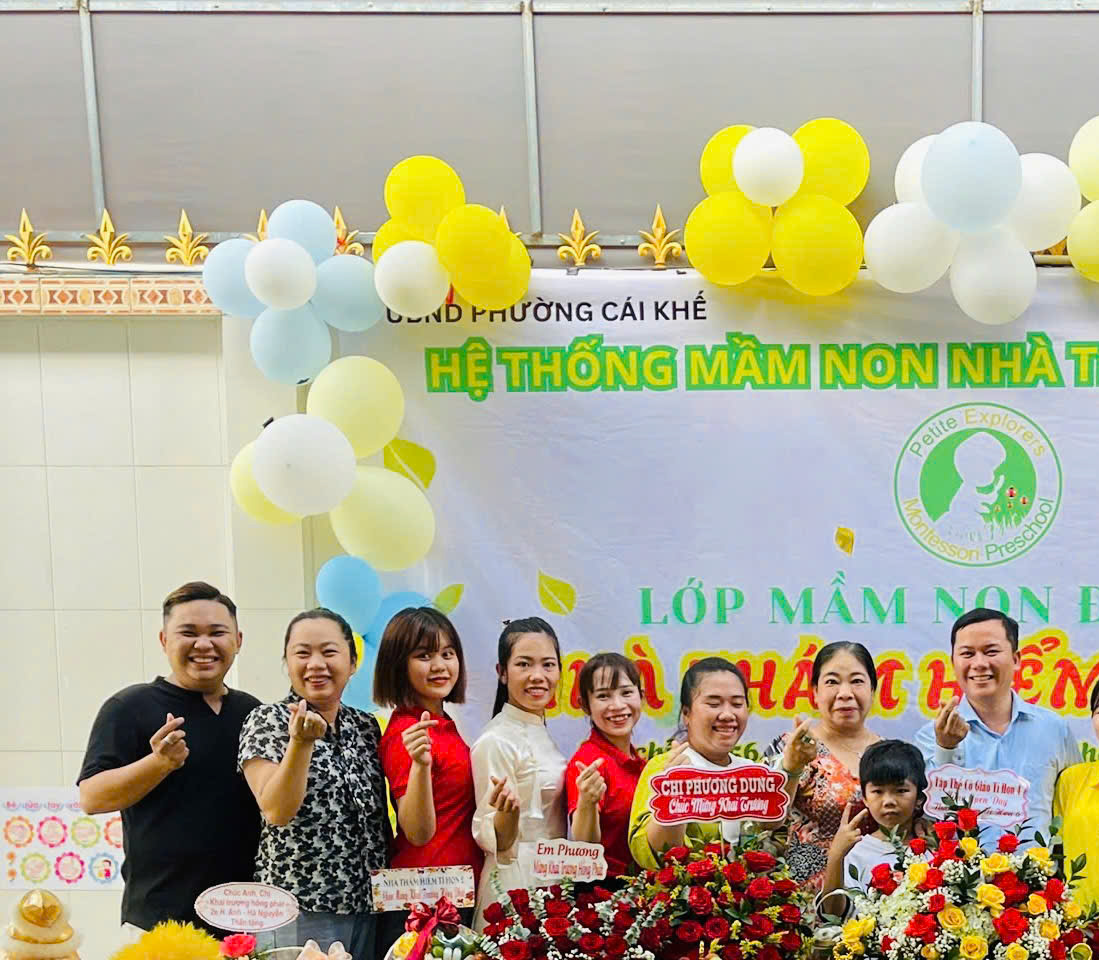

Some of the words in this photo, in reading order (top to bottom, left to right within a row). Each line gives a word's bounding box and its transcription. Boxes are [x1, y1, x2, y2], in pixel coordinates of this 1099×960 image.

[471, 297, 593, 323] PHƯỜNG
[601, 296, 644, 321] CÁI
[654, 291, 707, 321] KHẾ
[427, 338, 492, 400] HỆ
[498, 335, 676, 390] THỐNG
[687, 333, 810, 390] MẦM
[821, 343, 937, 389] NON
[948, 332, 1064, 387] NHÀ
[909, 417, 959, 457] Petite
[963, 407, 1046, 457] Explorers
[903, 498, 980, 561] Montessori
[984, 497, 1055, 560] Preschool
[639, 577, 745, 625] LỚP
[770, 570, 907, 624] MẦM
[932, 585, 1053, 624] NON
[740, 777, 776, 794] DUNG
[537, 843, 554, 855] Em
[557, 843, 600, 860] Phương
